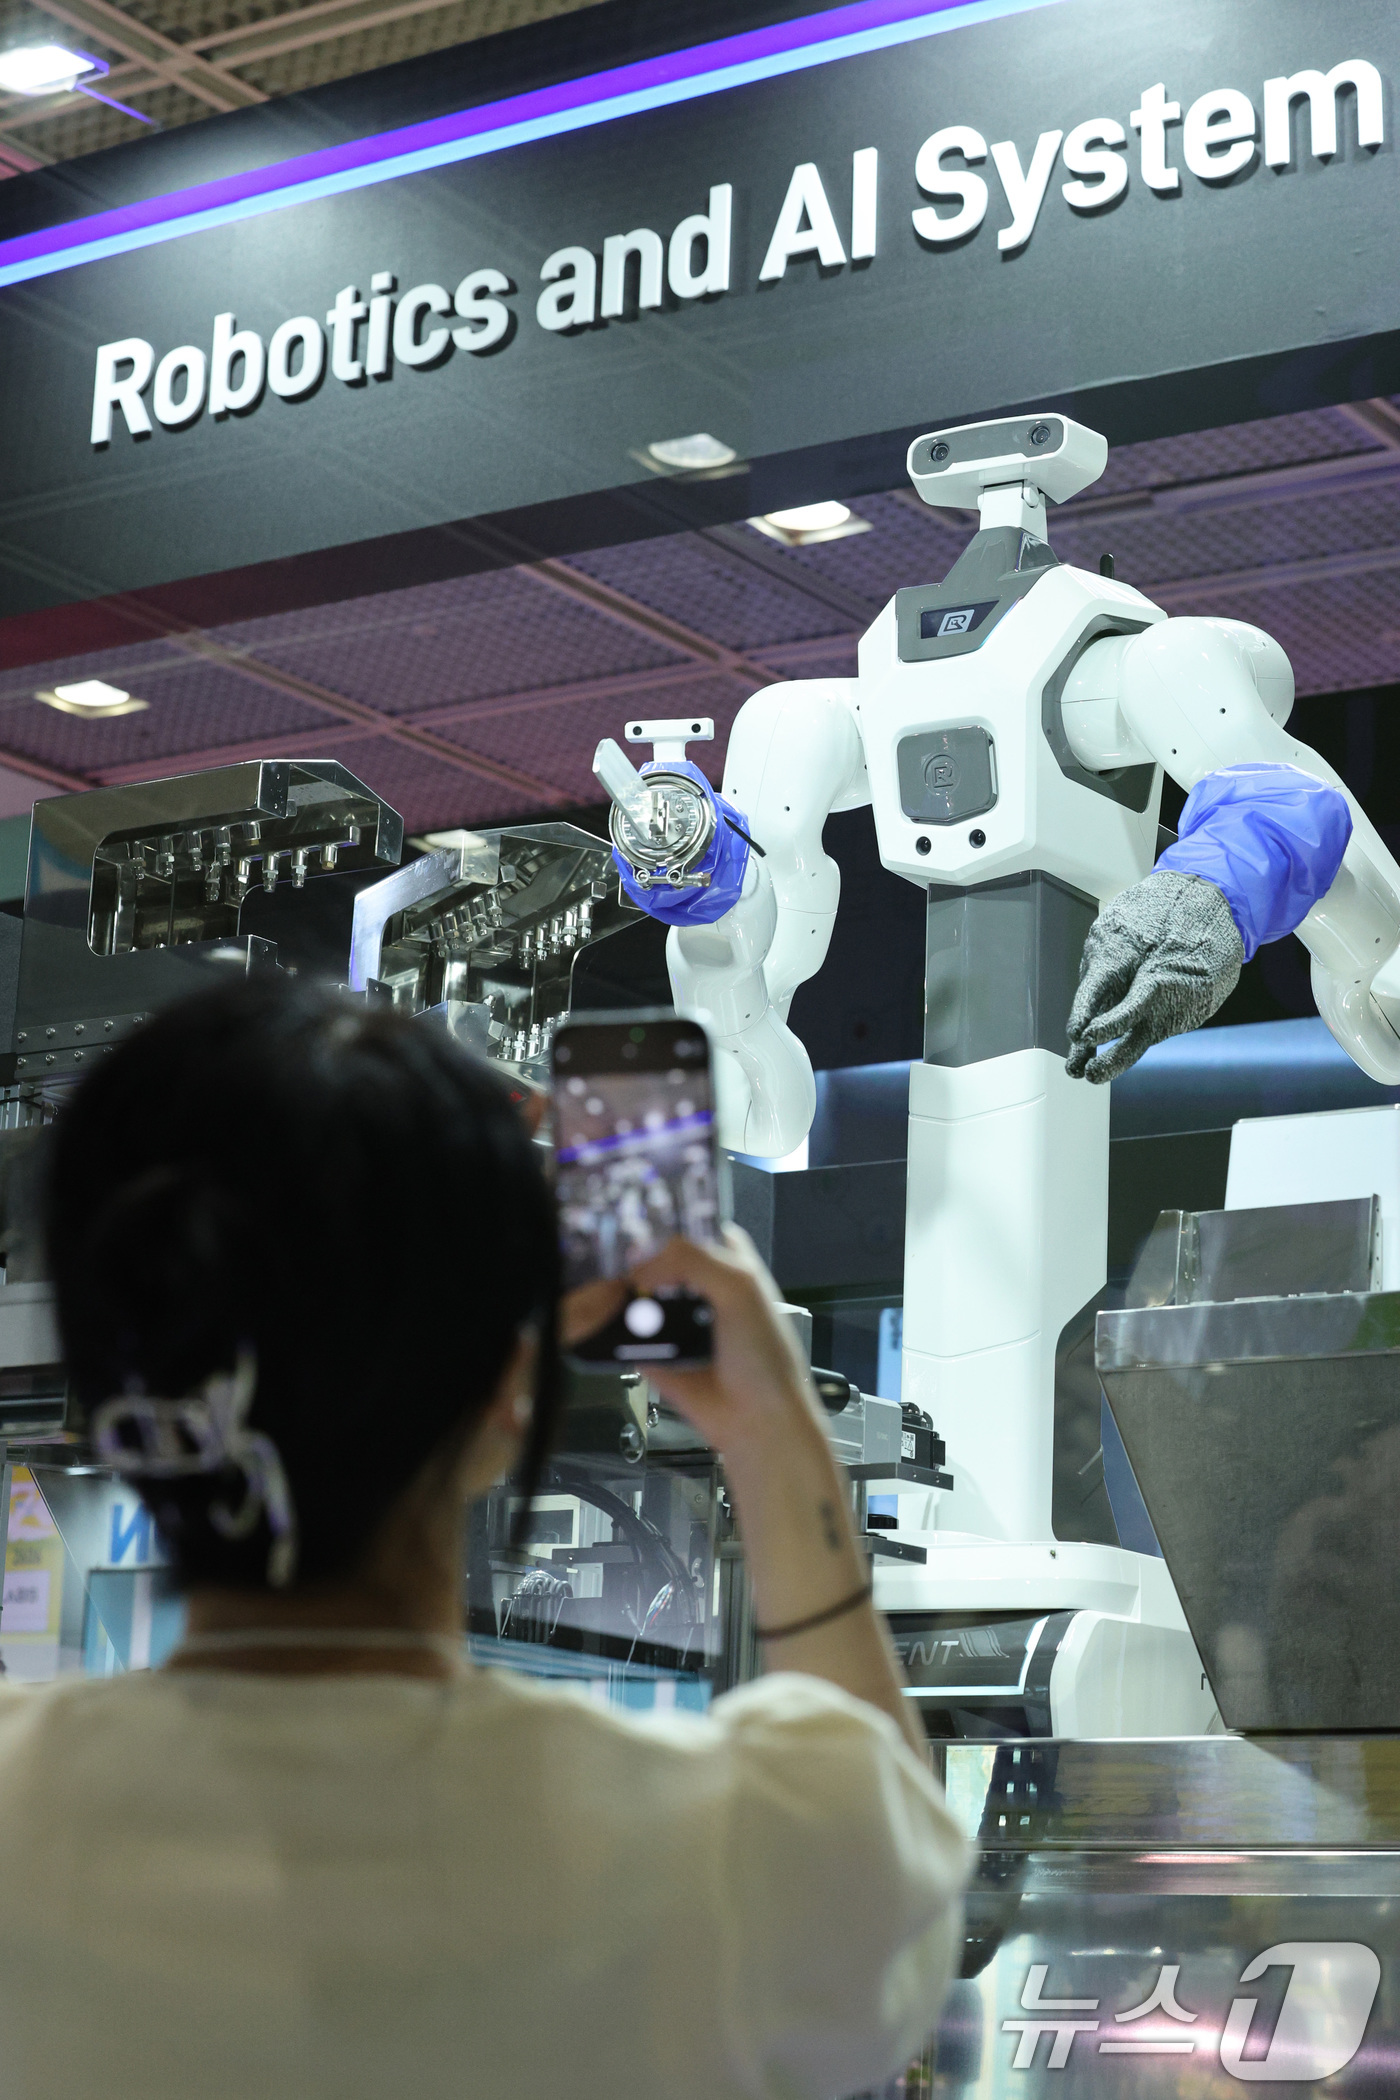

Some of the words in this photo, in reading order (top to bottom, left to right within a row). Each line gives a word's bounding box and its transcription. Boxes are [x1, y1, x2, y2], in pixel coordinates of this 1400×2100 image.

[91, 271, 511, 444] Robotics
[536, 182, 732, 333] and
[759, 147, 878, 282] AI
[911, 58, 1384, 251] System
